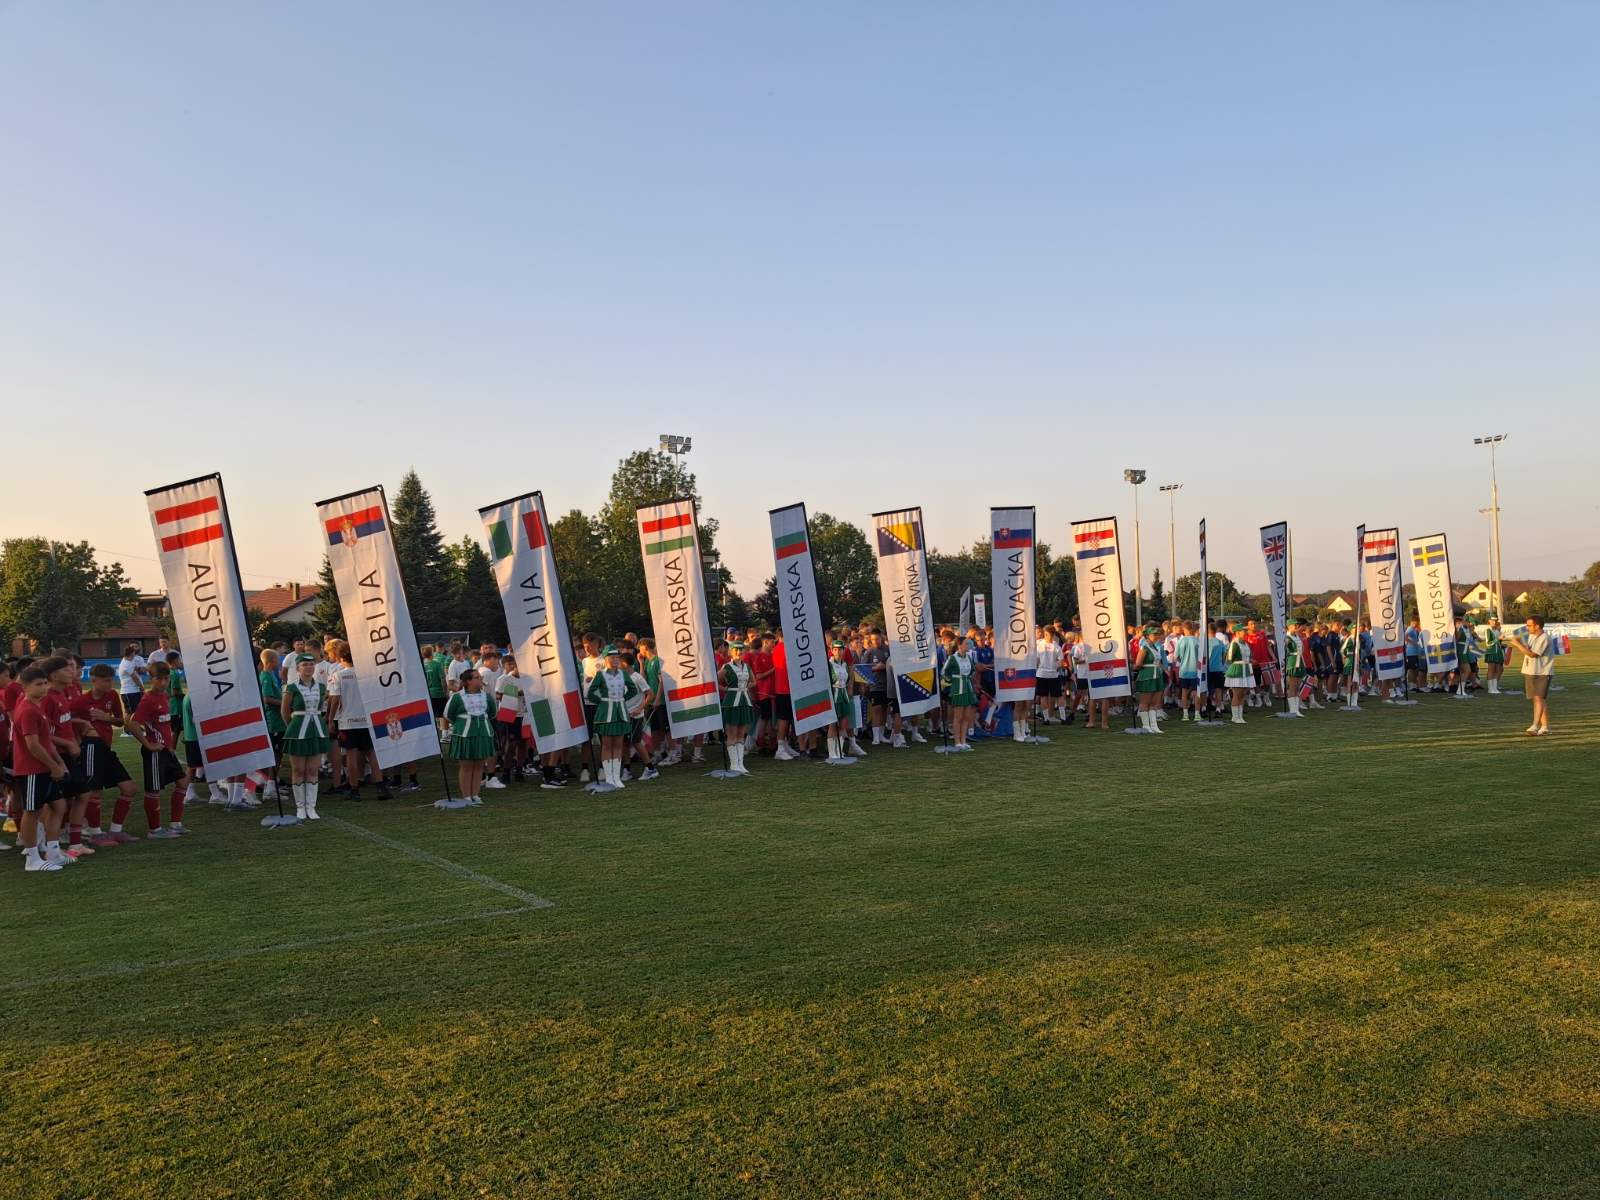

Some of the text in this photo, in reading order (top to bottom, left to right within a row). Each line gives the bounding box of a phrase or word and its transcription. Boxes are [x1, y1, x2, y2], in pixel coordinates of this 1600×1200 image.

[188, 563, 234, 700] AUSTRIJA
[358, 569, 402, 688] SRBIJA
[520, 572, 558, 677] ITALIJA
[664, 556, 698, 680] MAĐARSKA
[787, 560, 815, 681] BUGARSKA
[894, 595, 911, 643] BOSNA
[906, 563, 929, 660] HERCEGOVINA
[1003, 551, 1027, 655] SLOVAČKA
[1090, 563, 1114, 654] CROATIA
[1377, 566, 1397, 642] CROATIA
[1427, 568, 1448, 640] ŠVEDSKA
